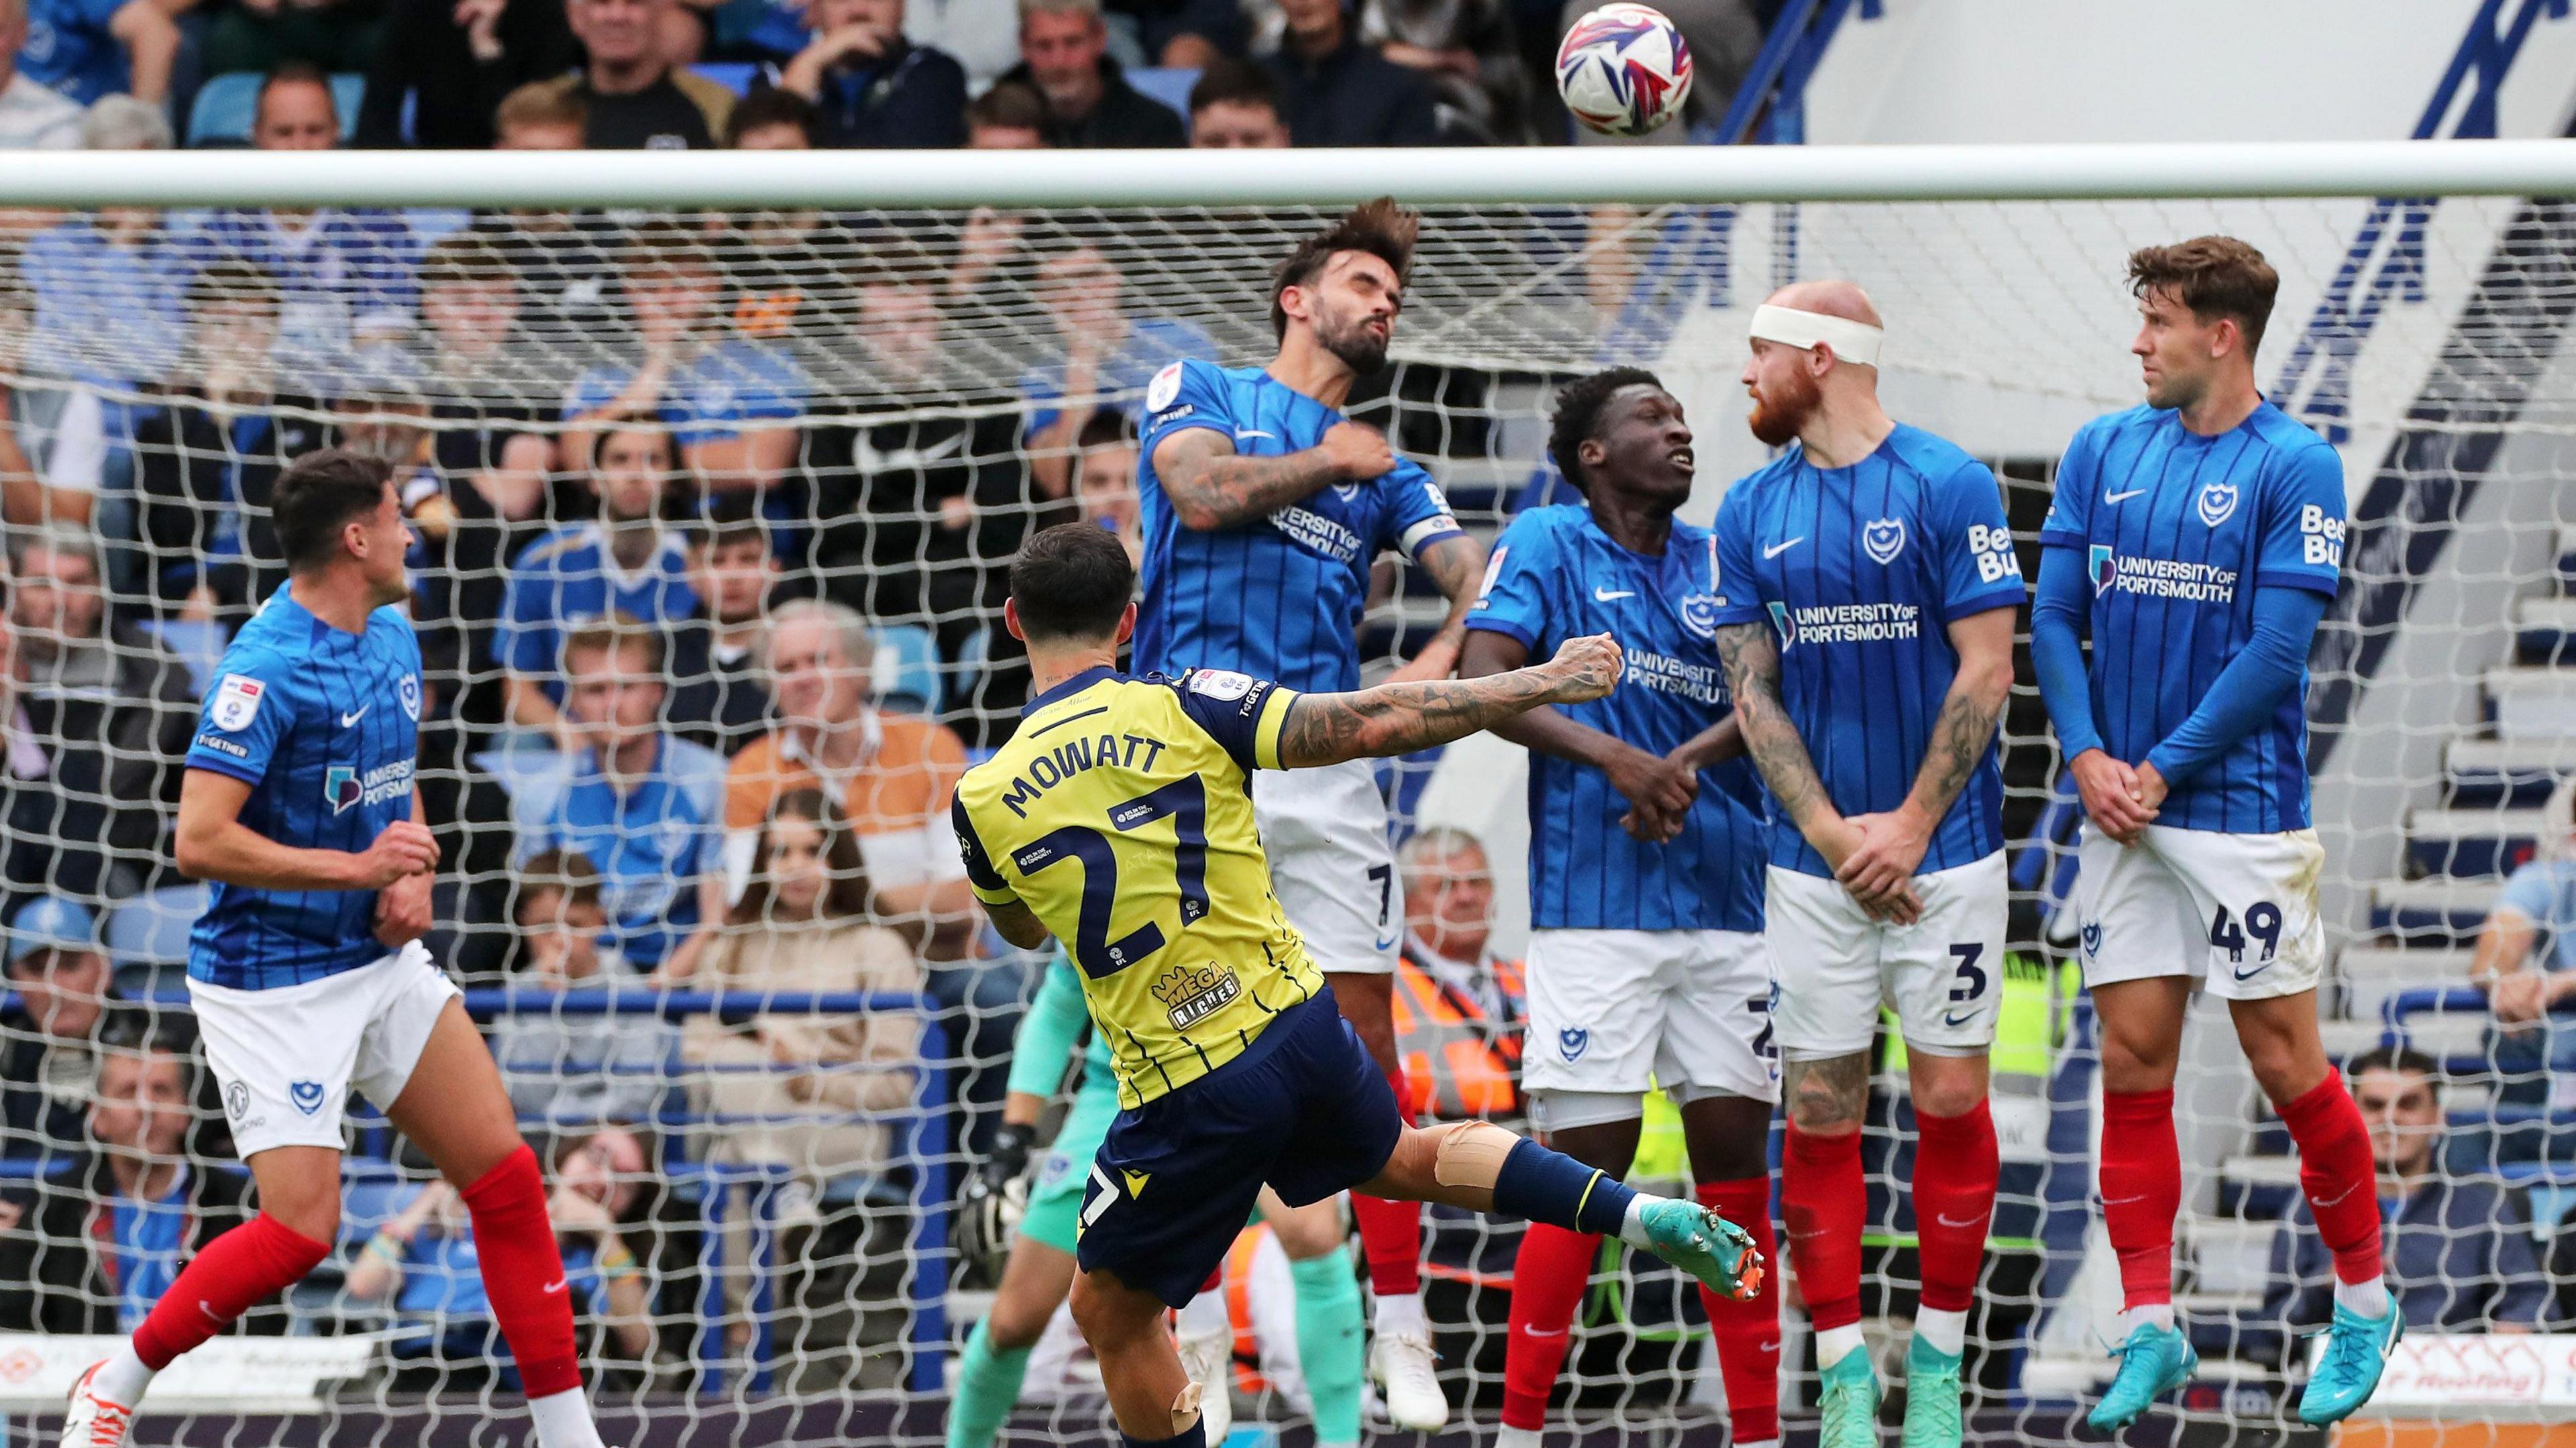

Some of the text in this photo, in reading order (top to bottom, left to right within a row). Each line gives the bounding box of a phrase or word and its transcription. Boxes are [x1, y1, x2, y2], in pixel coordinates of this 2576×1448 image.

[1968, 524, 2012, 554] Be
[2300, 504, 2346, 543] Bee
[1977, 551, 2023, 584] Bu
[2118, 555, 2237, 585] UNIVERSITY OF
[2304, 535, 2341, 573] Bu
[2116, 574, 2233, 604] PORTSMOUTH
[1795, 603, 1919, 625] UNIVERSITY OF
[1799, 620, 1918, 645] PORTSMOUTH
[1002, 735, 1165, 819] MOWATT
[1010, 771, 1210, 981] 27
[1368, 863, 1392, 926] 7
[1189, 909, 1200, 917] EFL
[2211, 901, 2282, 962] 49
[1116, 958, 1127, 966] EFL
[1949, 942, 1986, 1001] 3
[1167, 961, 1227, 1007] MEGA
[1174, 980, 1236, 1025] RICHES
[1083, 1162, 1120, 1227] 7
